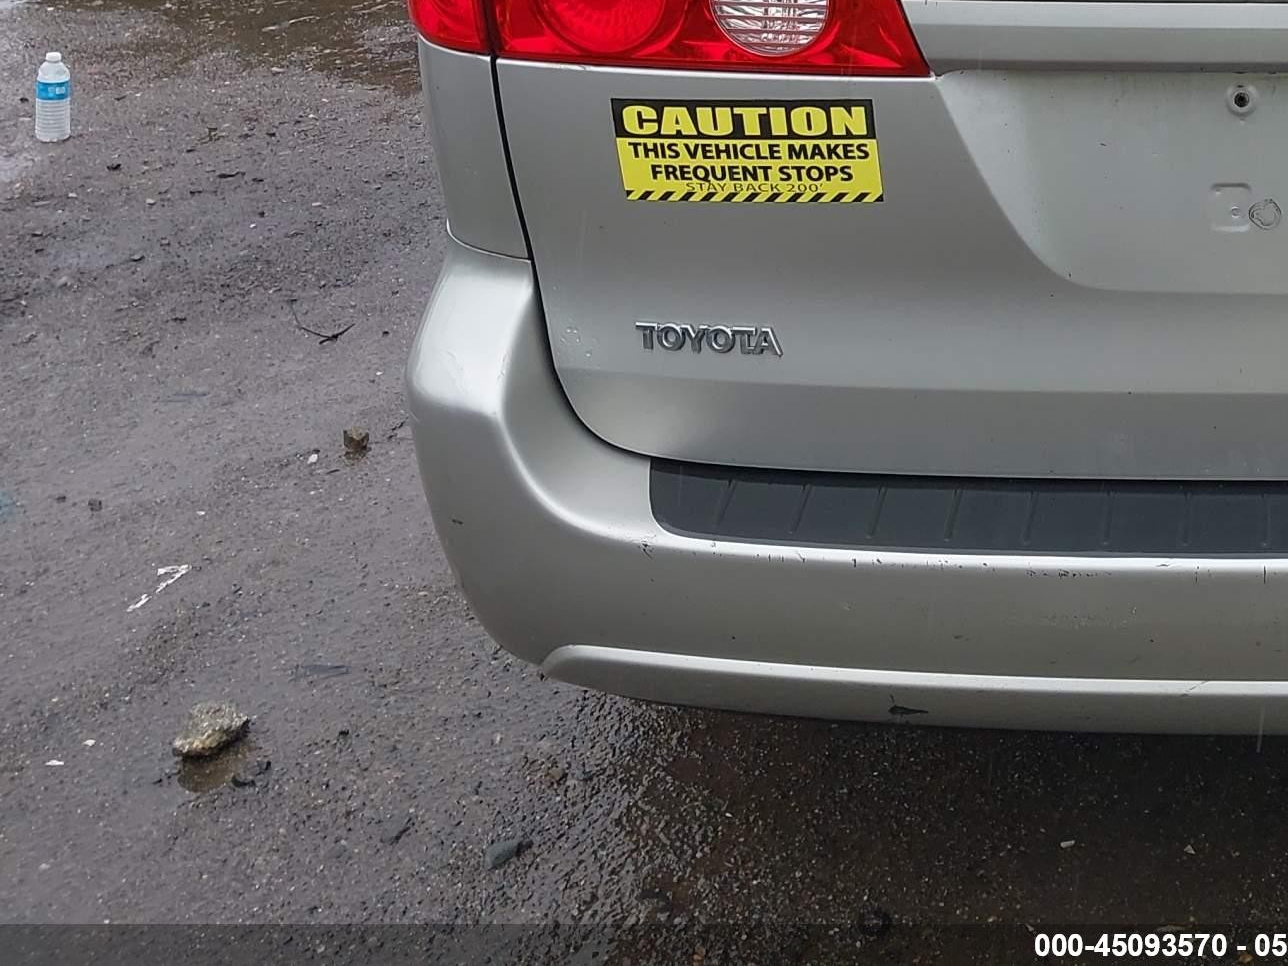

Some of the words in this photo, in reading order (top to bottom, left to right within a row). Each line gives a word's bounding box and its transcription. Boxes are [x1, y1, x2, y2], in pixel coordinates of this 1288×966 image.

[621, 105, 868, 136] CAUTION
[628, 142, 681, 159] THIS
[683, 143, 782, 160] VEHICLE
[788, 143, 870, 160] MAKES
[651, 164, 772, 183] FREQUENT
[779, 165, 853, 182] STOPS
[686, 182, 728, 192] STAY
[733, 182, 782, 192] BACK
[787, 183, 823, 192] 200'
[635, 321, 783, 357] TOYOTA
